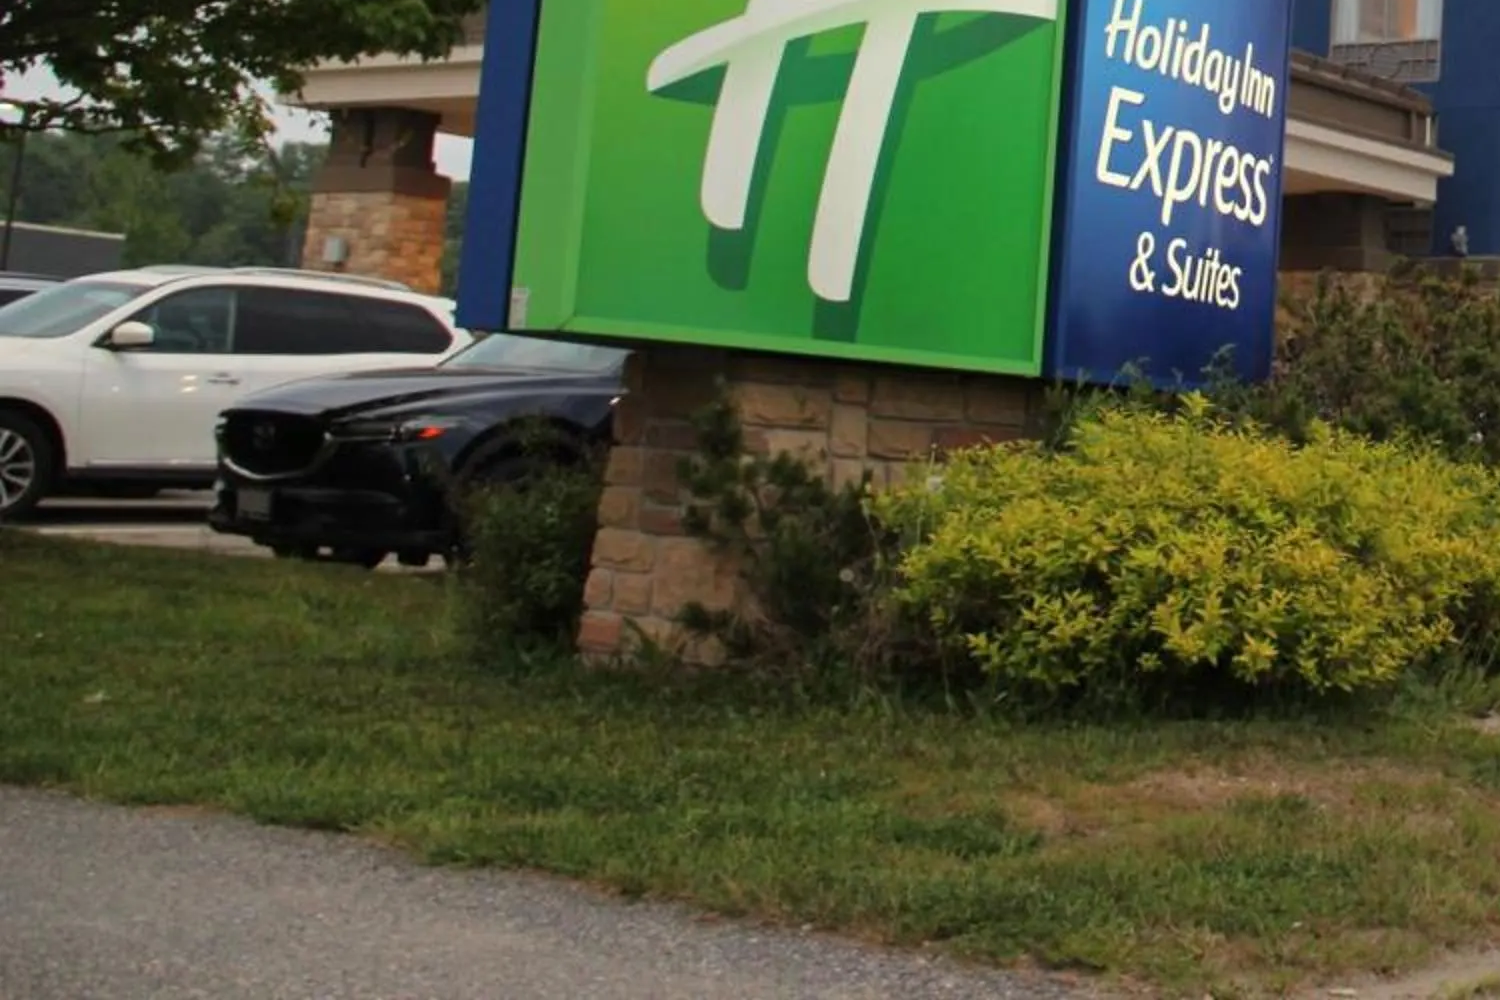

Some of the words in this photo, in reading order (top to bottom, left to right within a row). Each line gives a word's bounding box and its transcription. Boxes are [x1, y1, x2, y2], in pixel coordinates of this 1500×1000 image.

[1240, 42, 1275, 118] Inn
[1096, 86, 1271, 226] Express
[1129, 231, 1156, 292] &
[1161, 238, 1241, 309] Suites
